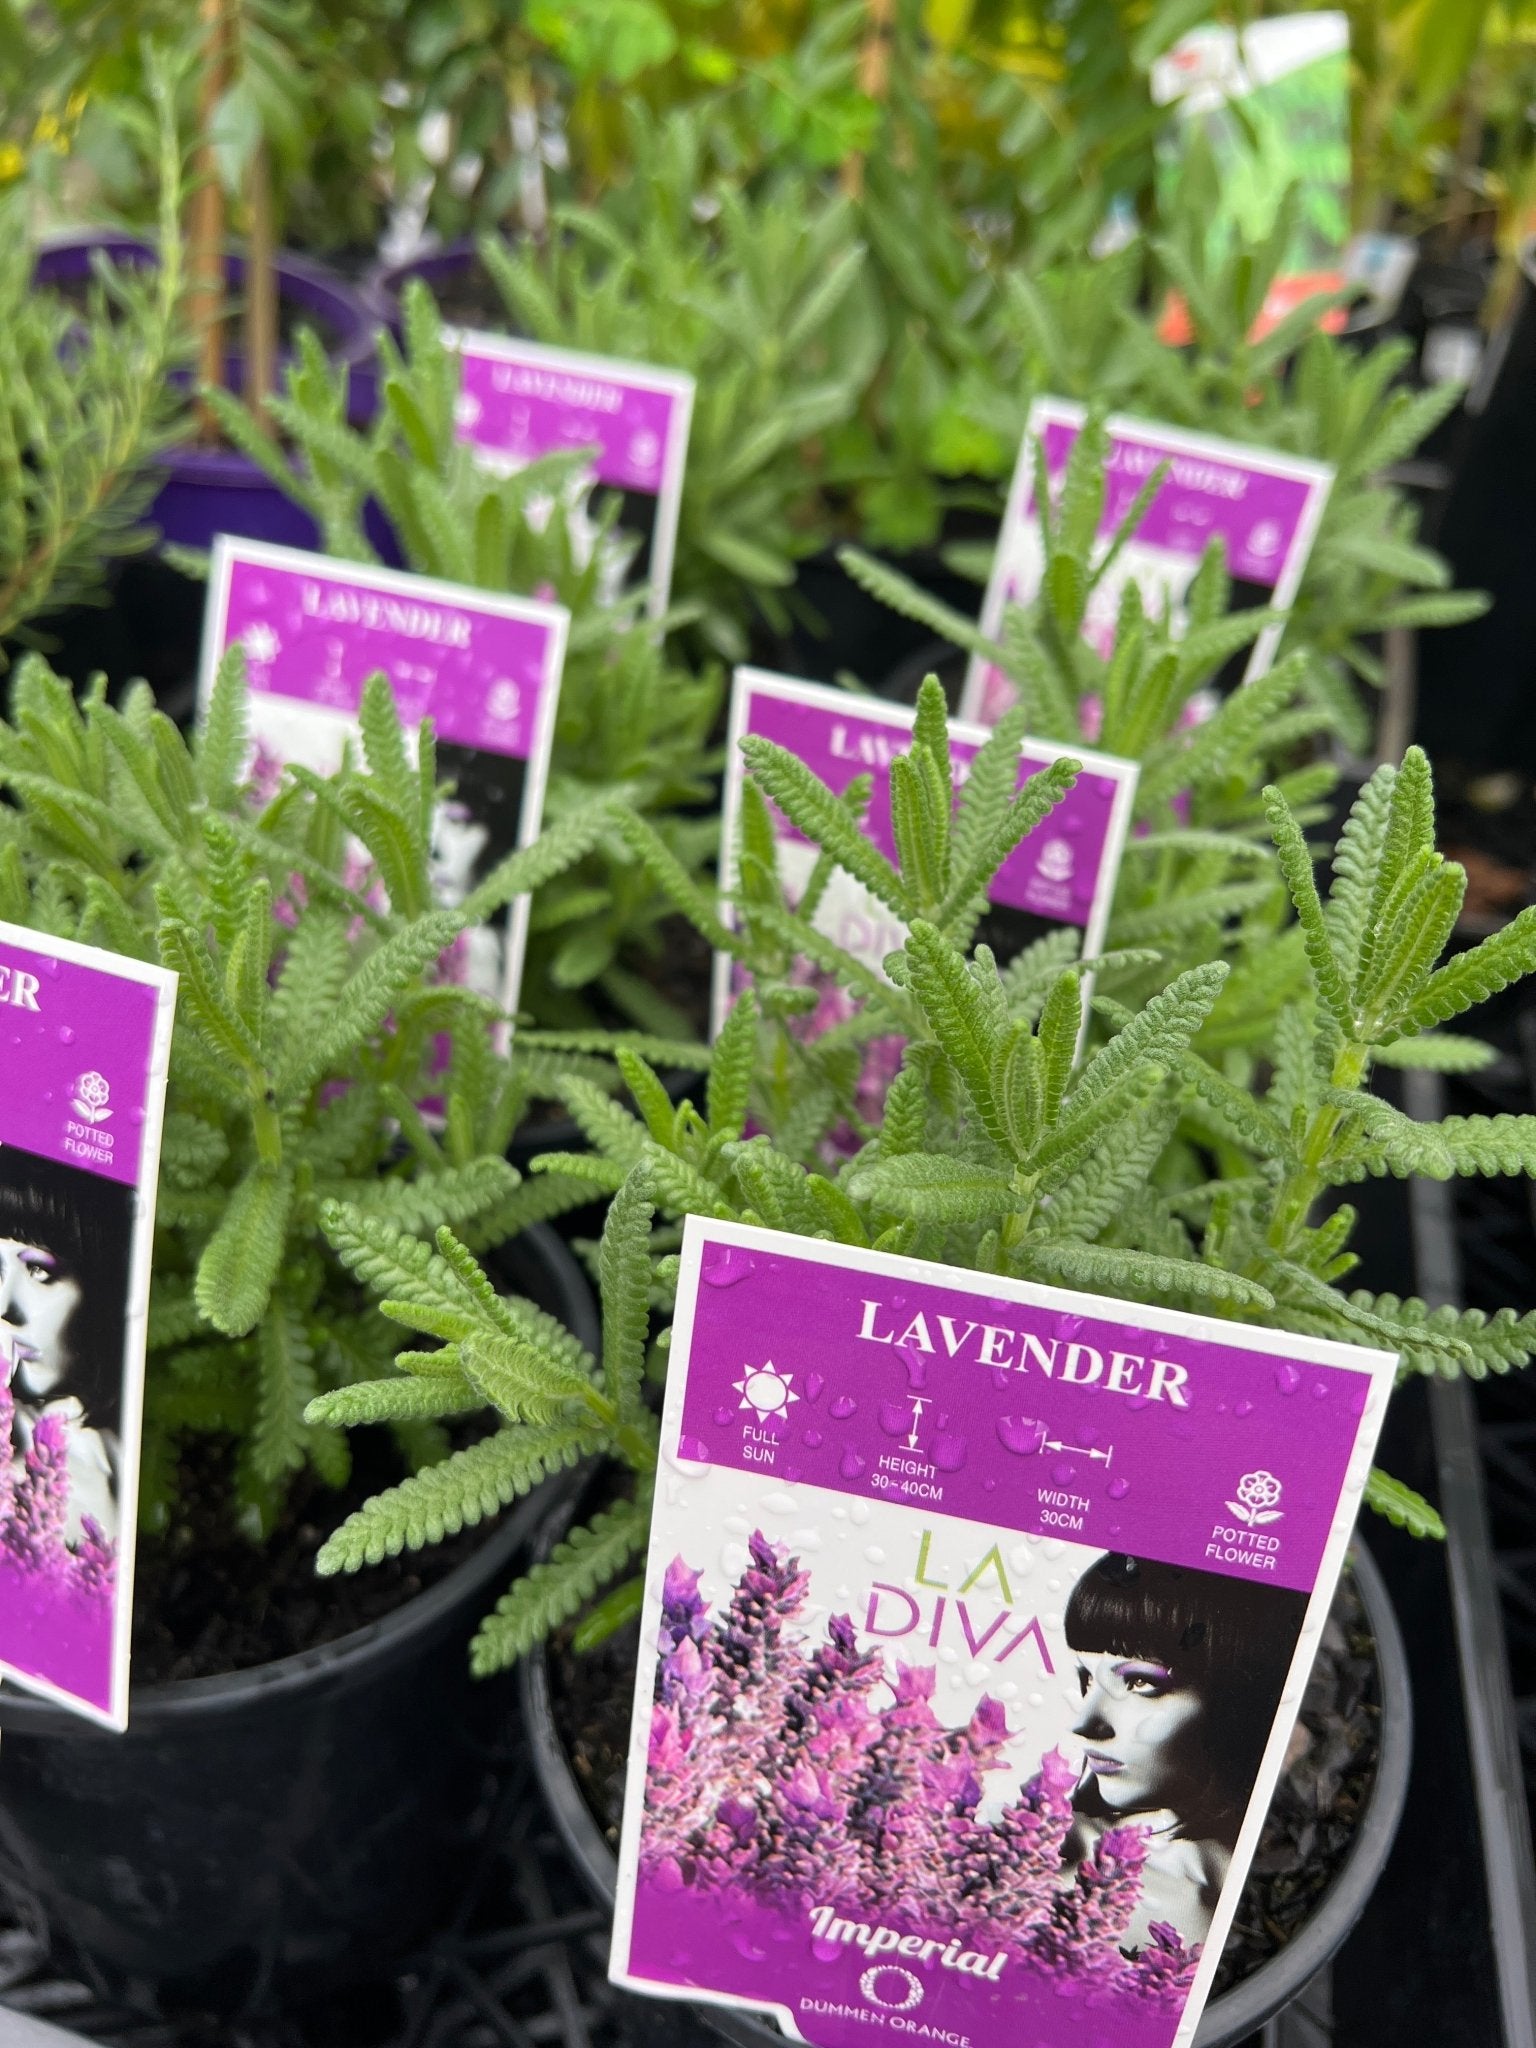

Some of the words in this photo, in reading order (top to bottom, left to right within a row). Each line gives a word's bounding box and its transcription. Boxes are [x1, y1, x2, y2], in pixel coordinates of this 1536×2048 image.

[302, 579, 473, 649] LAVENDER
[66, 1120, 114, 1148] POTTED
[64, 1138, 113, 1165] FLOWER
[856, 1299, 1192, 1408] LAVENDER
[742, 1425, 780, 1446] FULL
[742, 1445, 776, 1464] SUN
[878, 1454, 938, 1479] HEIGHT
[1037, 1488, 1090, 1512] WIDTH
[1039, 1510, 1083, 1530] 30CM
[1211, 1525, 1280, 1552] POTTED
[915, 1529, 1014, 1605] LA
[1205, 1543, 1276, 1570] FLOWER
[865, 1581, 1056, 1675] DIVA
[809, 1906, 1009, 1981] Imperial
[889, 2016, 972, 2048] ORANGE
